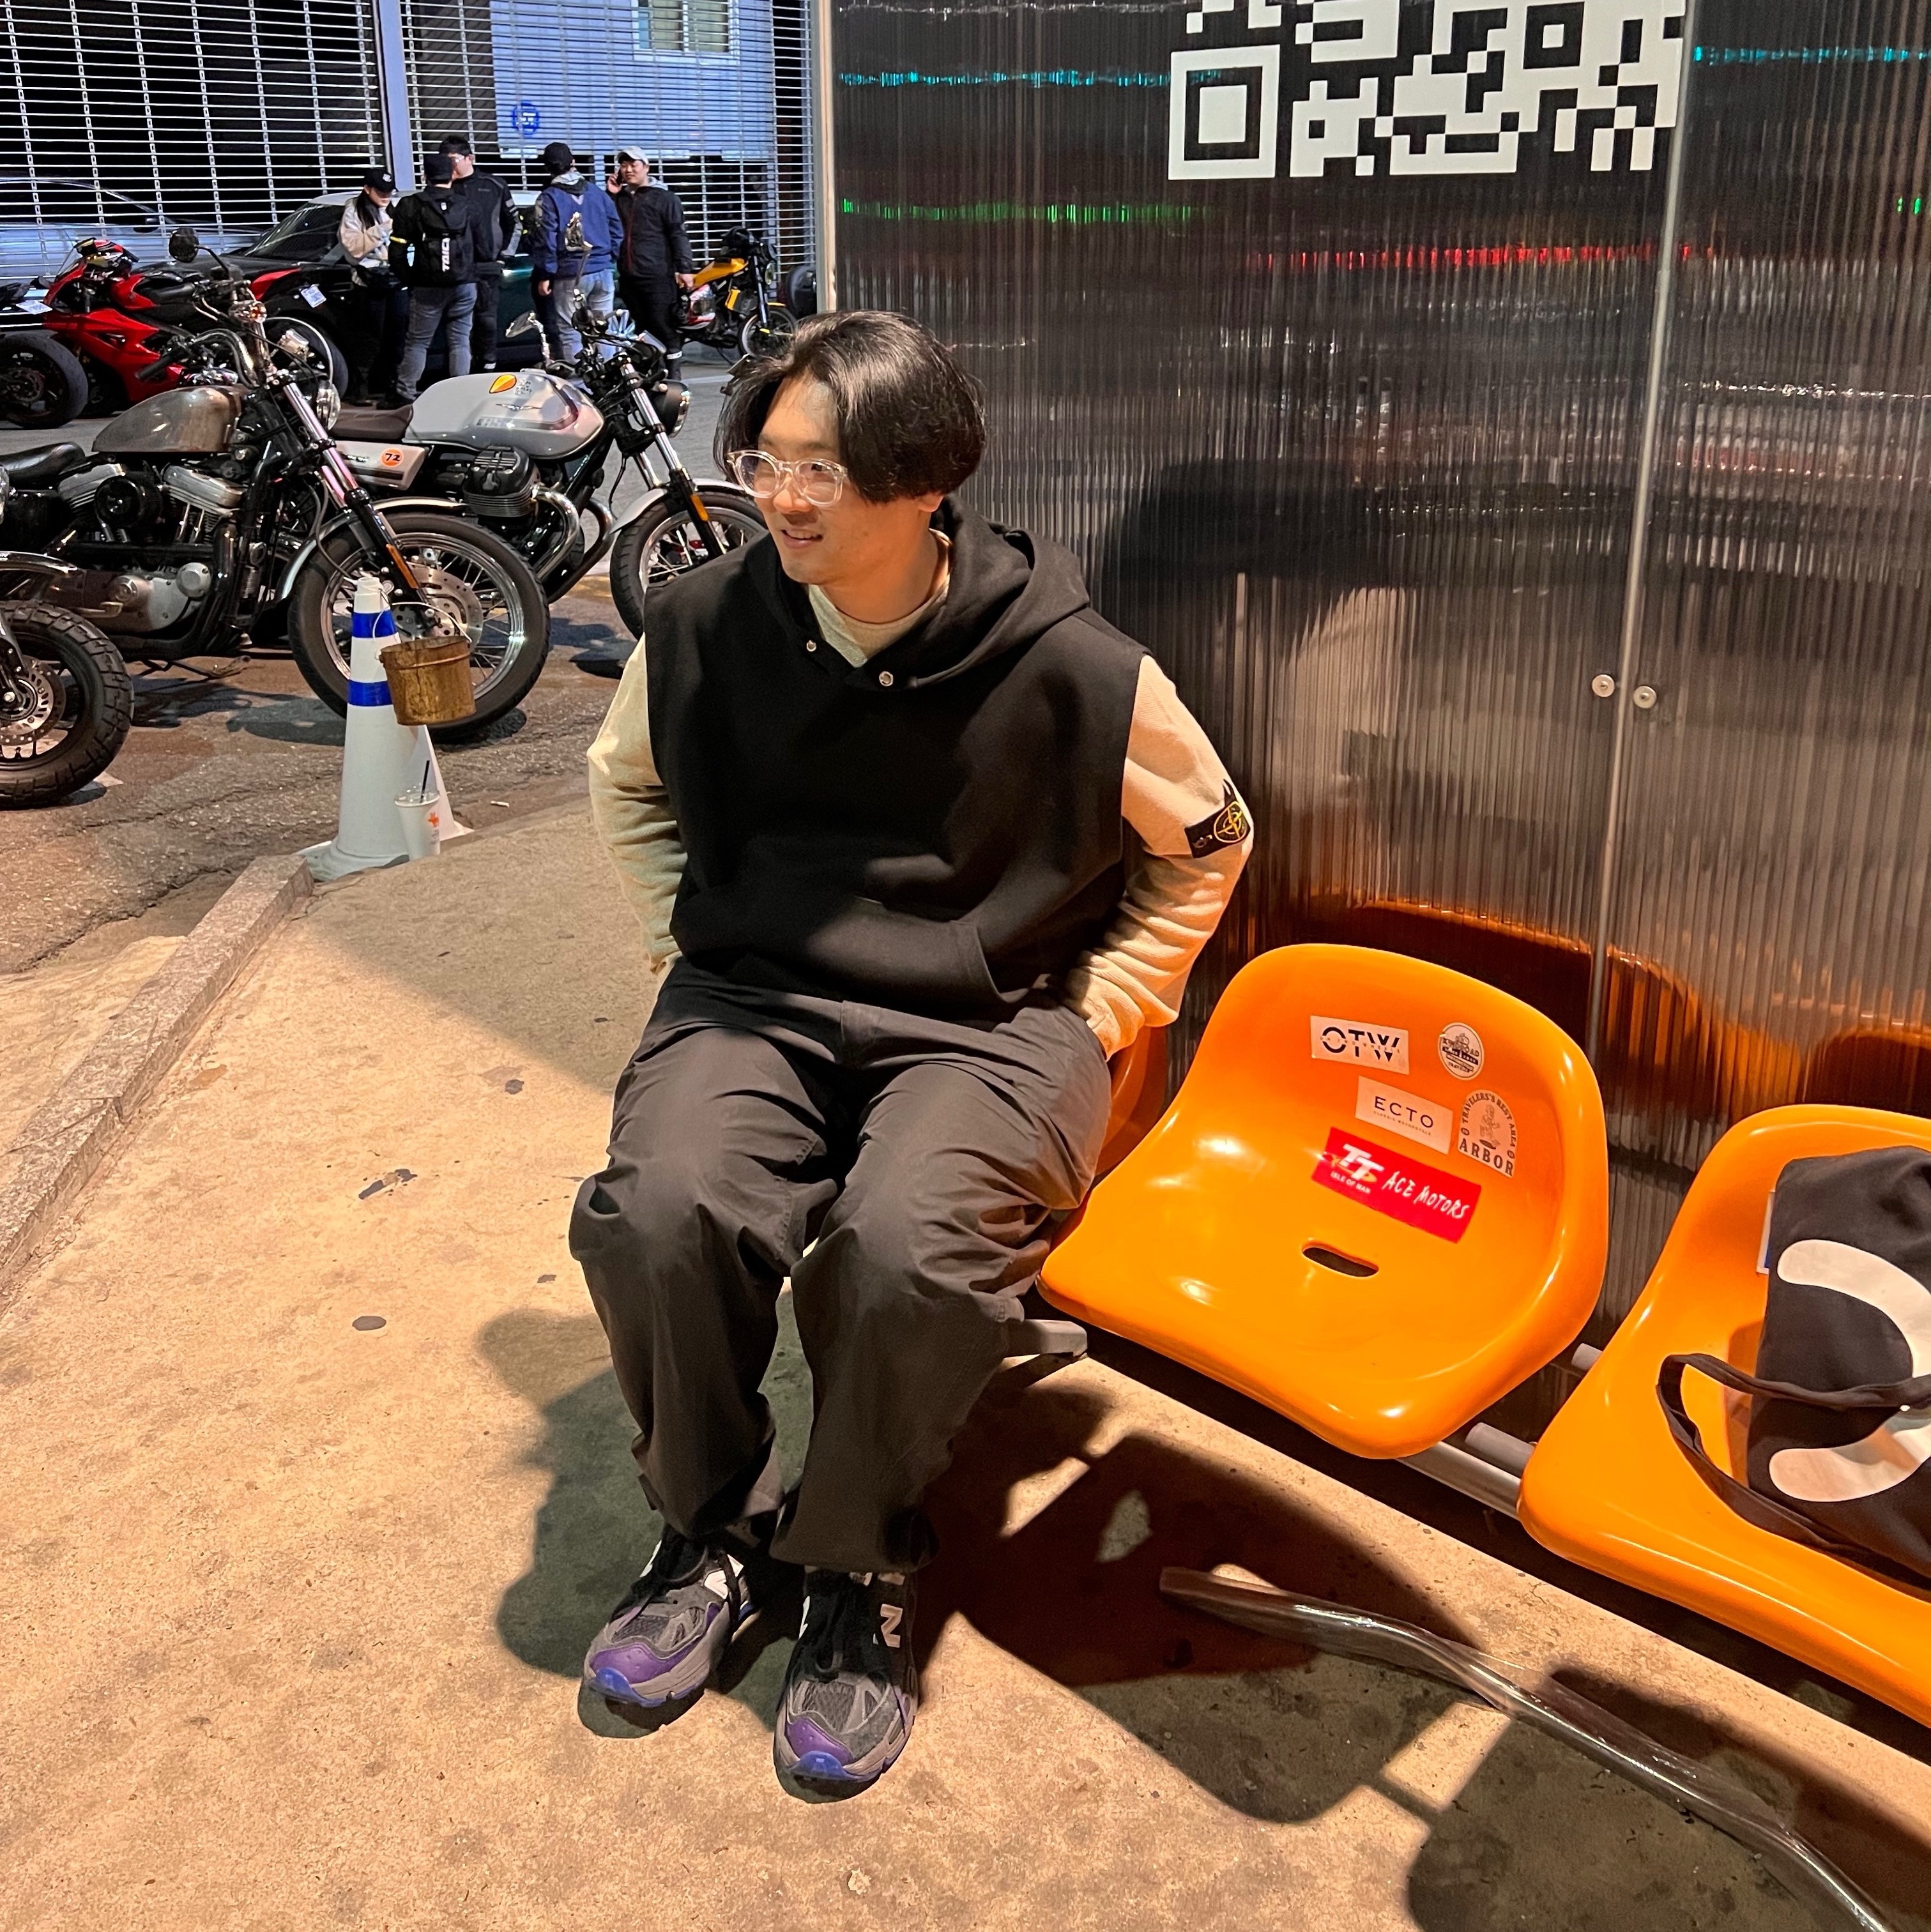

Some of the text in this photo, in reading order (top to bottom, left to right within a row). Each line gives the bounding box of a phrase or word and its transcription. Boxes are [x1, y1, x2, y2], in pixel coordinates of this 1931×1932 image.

[385, 453, 401, 462] 72
[1322, 1026, 1400, 1062] OTW
[1374, 1095, 1433, 1128] ECTO
[1496, 1099, 1512, 1120] REST
[1338, 1143, 1385, 1180] TT
[1459, 1137, 1513, 1176] ARBOR
[1346, 1178, 1355, 1187] OF
[1355, 1182, 1371, 1194] MAN
[1382, 1171, 1470, 1219] ACE MOTORS
